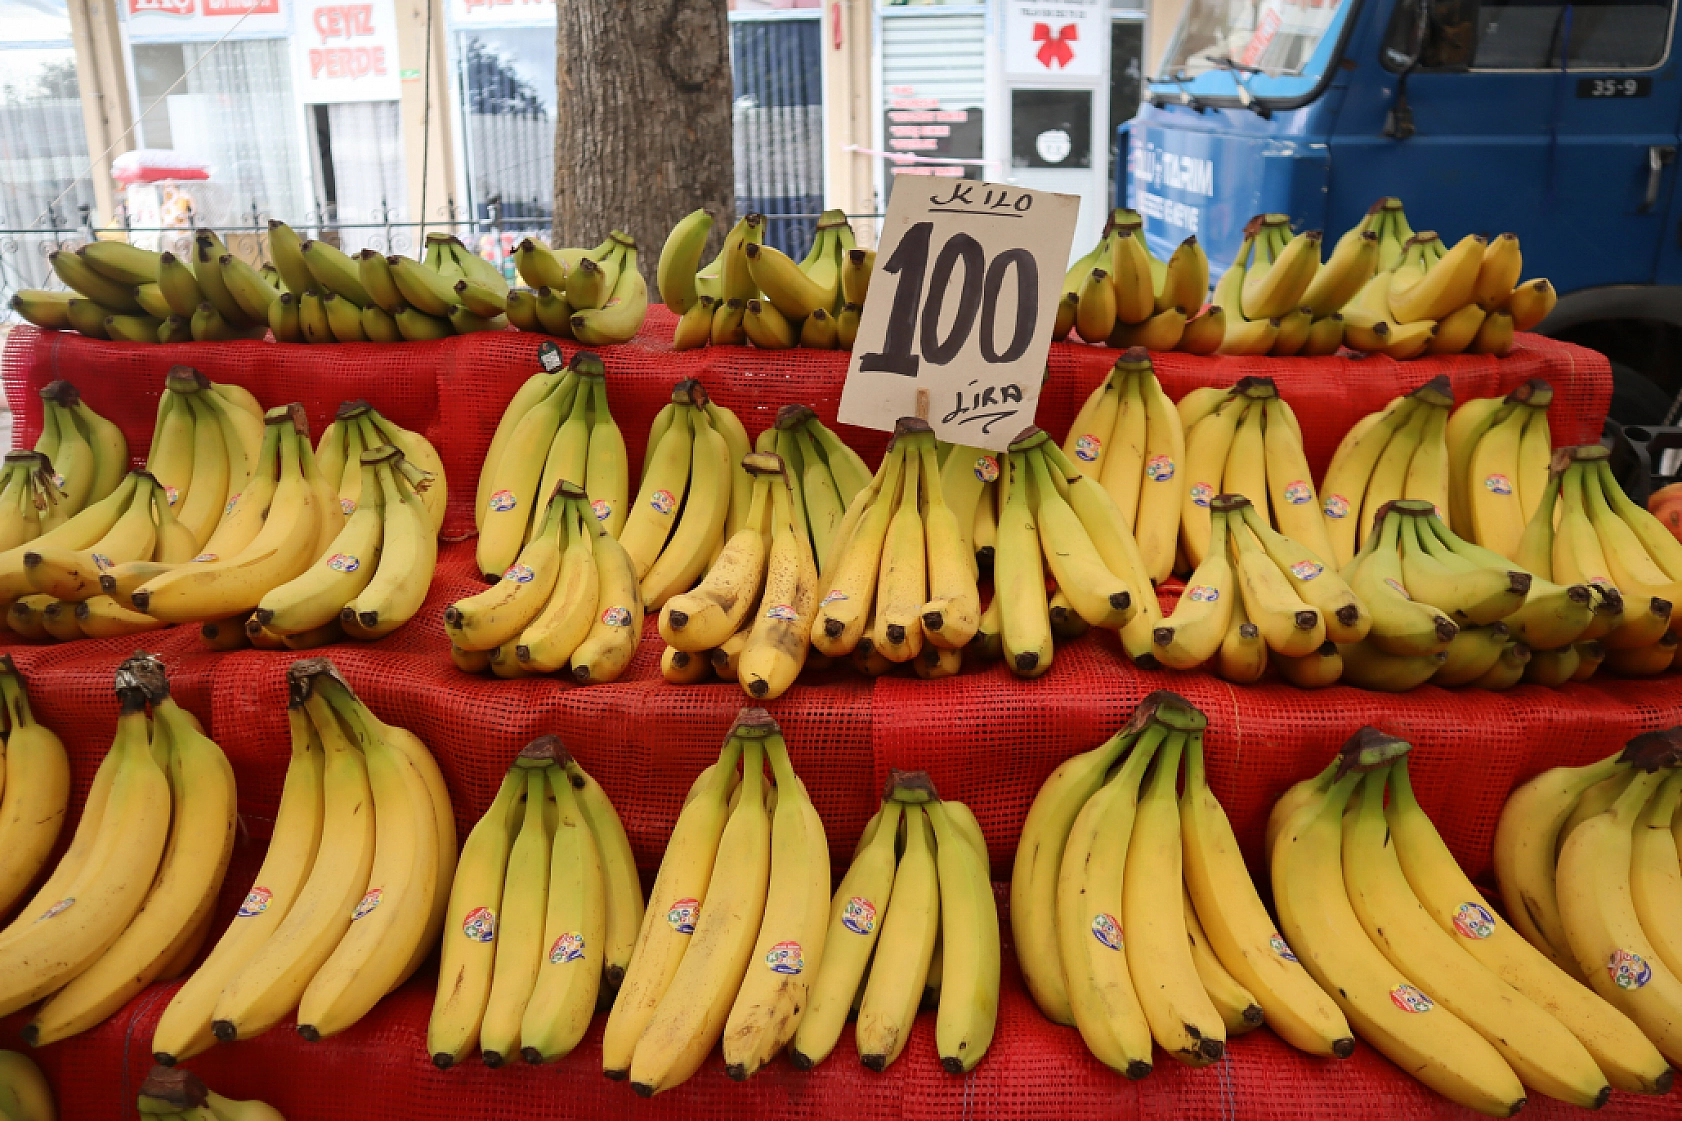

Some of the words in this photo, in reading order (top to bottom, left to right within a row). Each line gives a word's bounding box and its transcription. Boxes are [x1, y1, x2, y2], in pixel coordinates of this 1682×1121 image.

[308, 45, 387, 80] PERDE
[1592, 79, 1637, 96] 35-9
[859, 221, 1039, 378] 100
